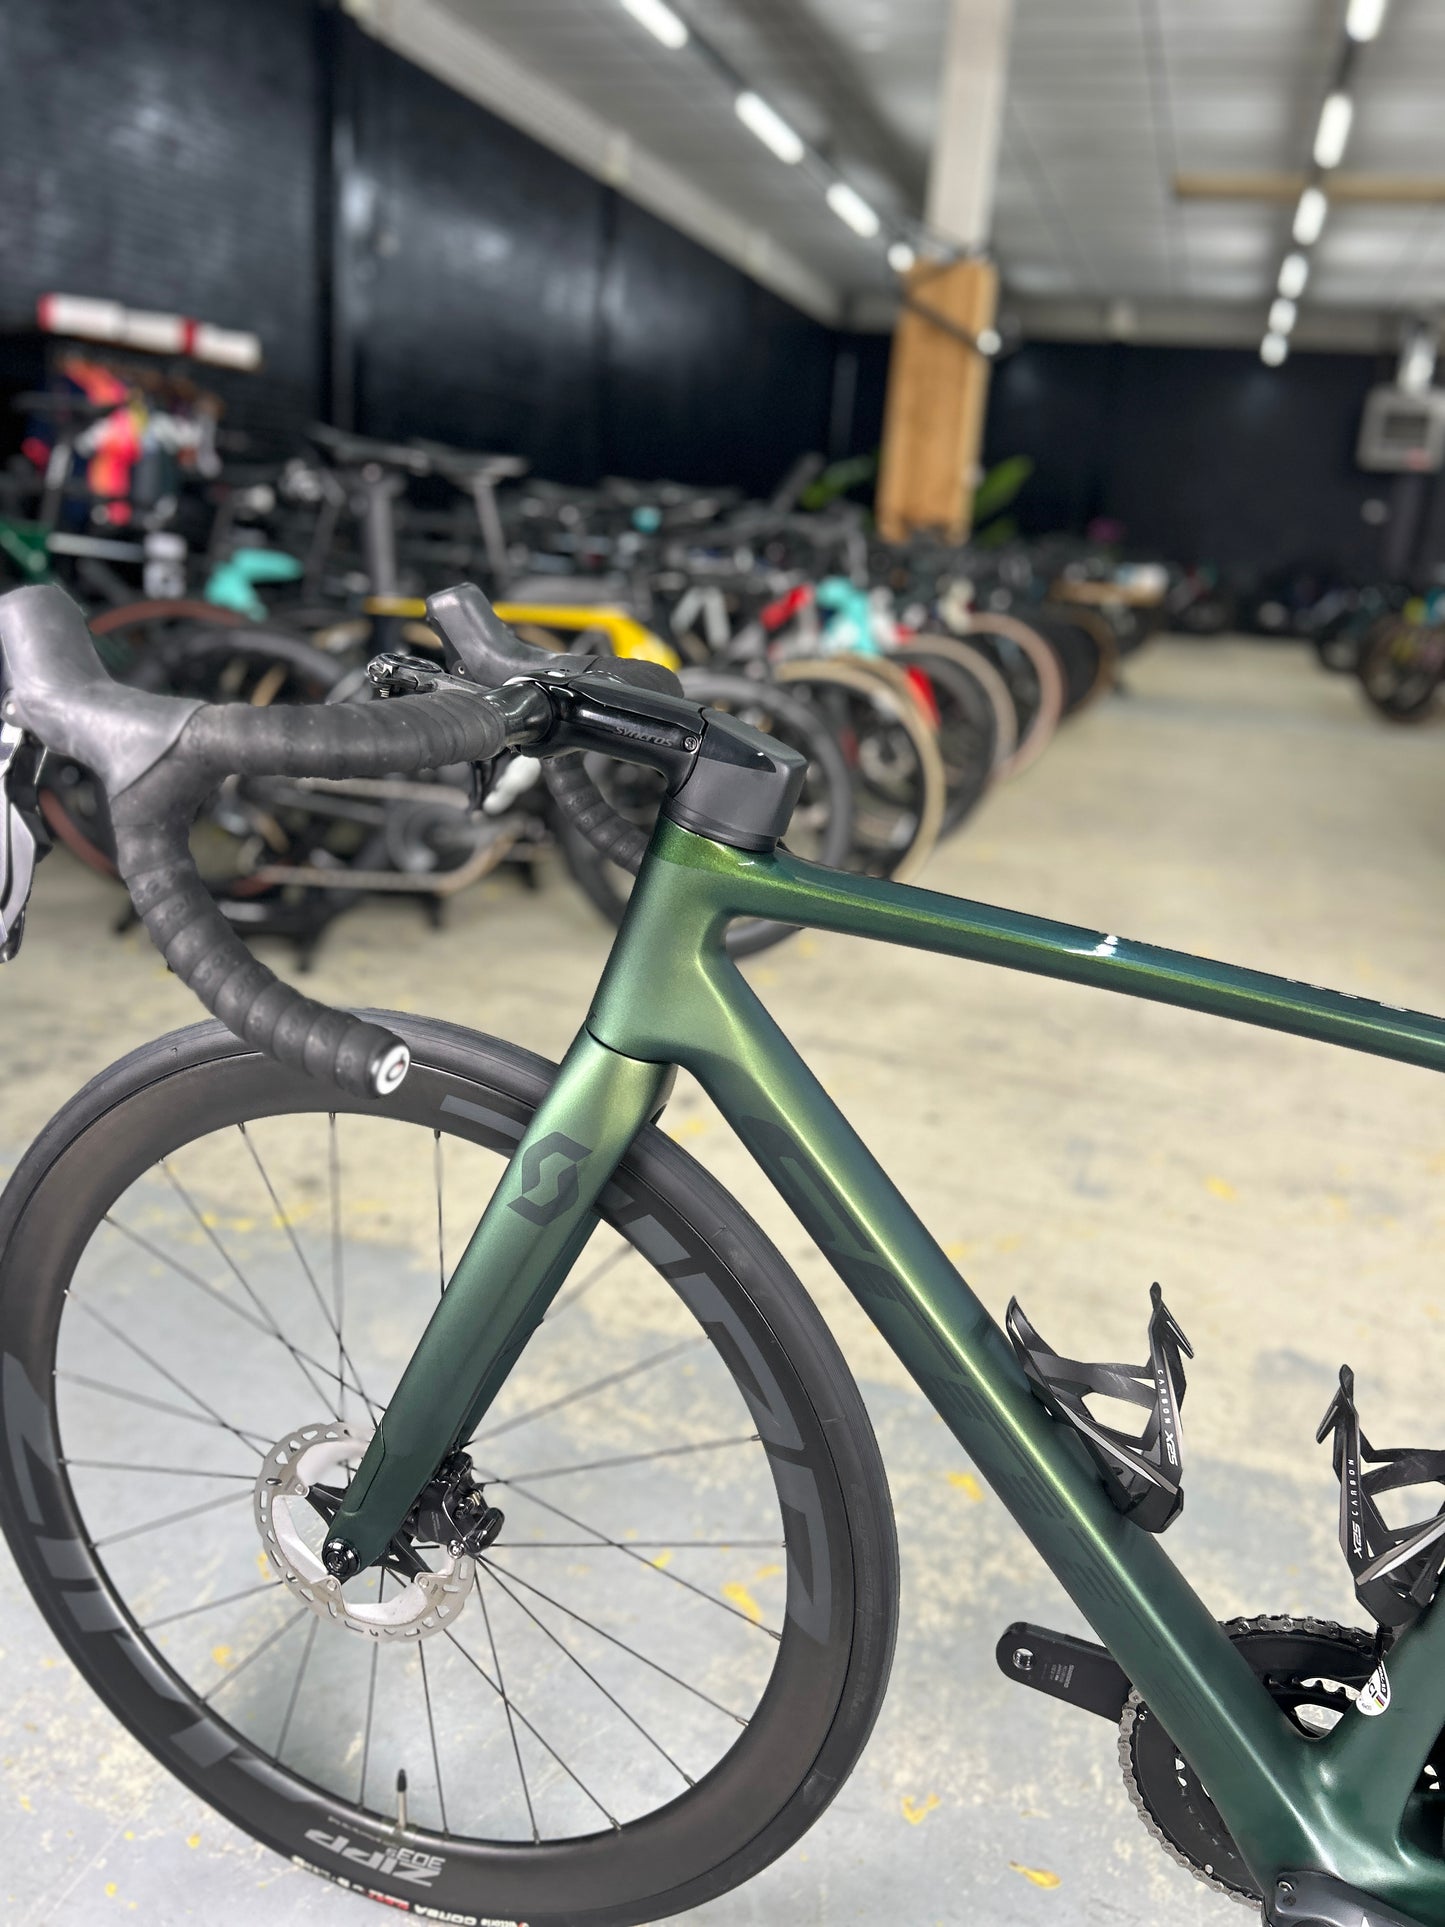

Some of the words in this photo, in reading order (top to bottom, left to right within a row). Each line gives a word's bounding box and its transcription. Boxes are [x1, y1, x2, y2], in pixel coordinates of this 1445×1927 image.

[1157, 1368, 1171, 1424] CARBON
[1347, 1458, 1359, 1516] CARBON
[304, 1828, 443, 1887] ZIPP
